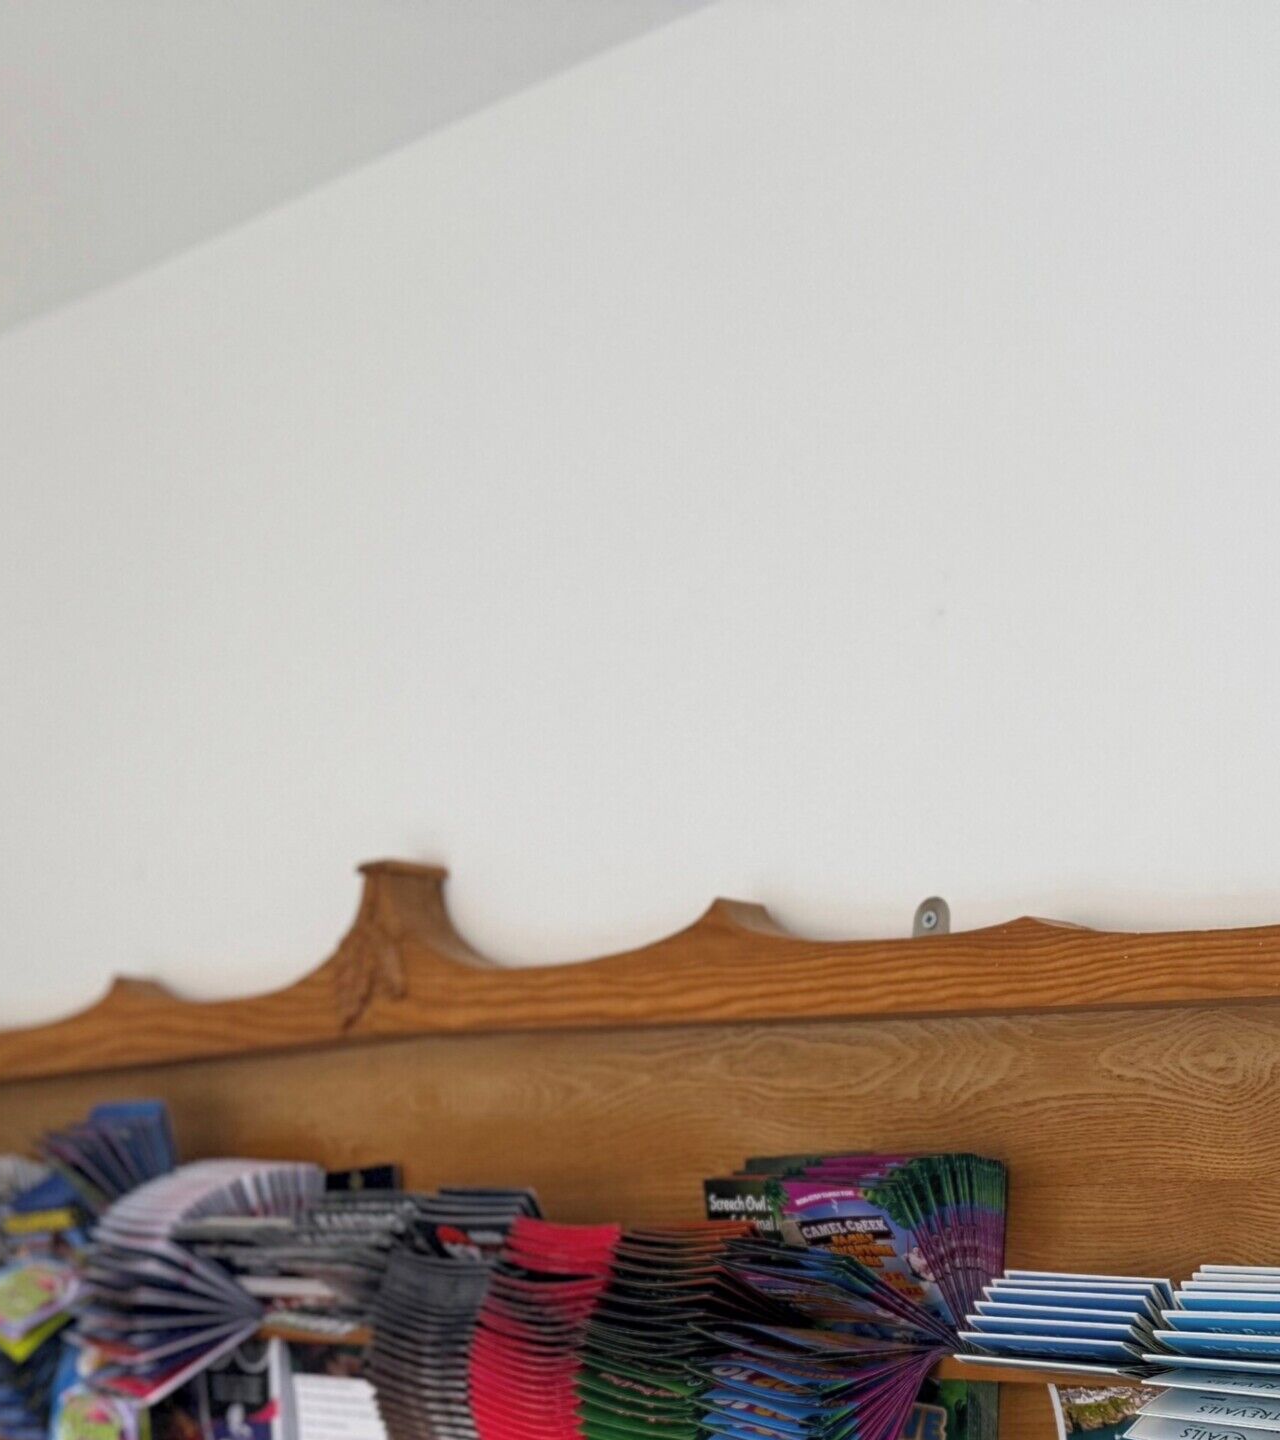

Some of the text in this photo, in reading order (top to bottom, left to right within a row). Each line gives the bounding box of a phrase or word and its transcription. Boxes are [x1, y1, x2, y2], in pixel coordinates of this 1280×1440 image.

[746, 1194, 766, 1211] Owl
[802, 1216, 888, 1239] CAMEL CREEK
